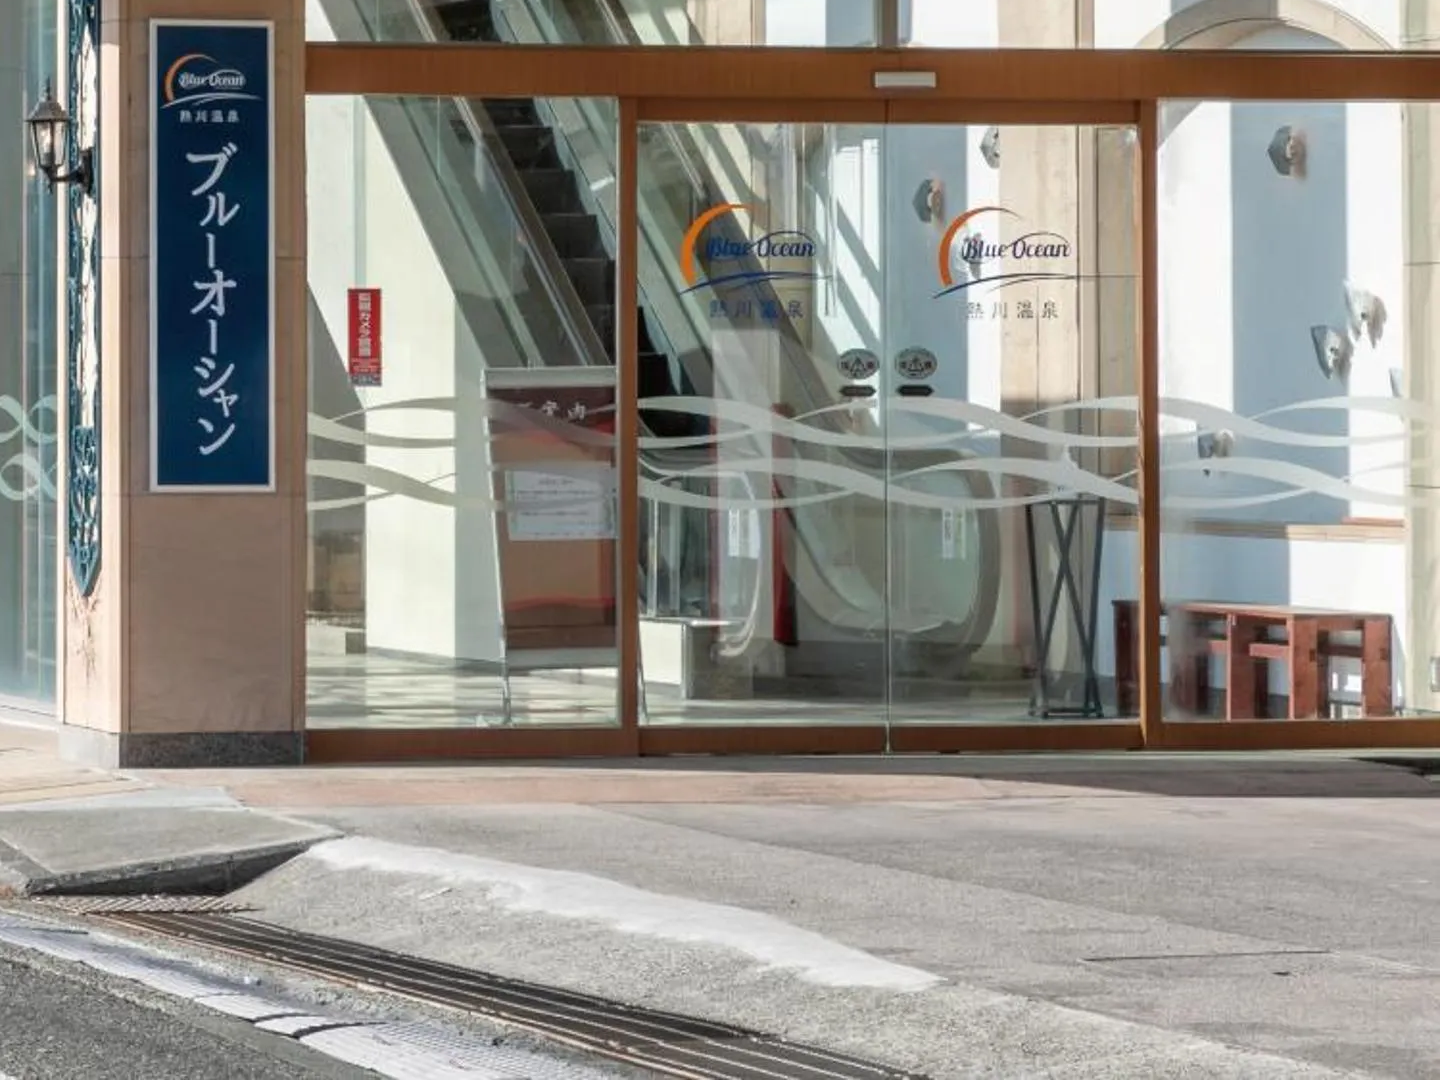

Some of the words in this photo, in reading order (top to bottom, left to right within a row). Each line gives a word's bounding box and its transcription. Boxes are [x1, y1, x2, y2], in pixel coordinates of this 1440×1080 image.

[178, 72, 207, 88] Blue
[208, 70, 246, 87] Ocean
[707, 237, 753, 259] Blue
[756, 232, 815, 258] Ocean
[961, 237, 1009, 262] Blue
[1011, 233, 1071, 259] Ocean
[185, 142, 240, 455] ブルーオーシャン
